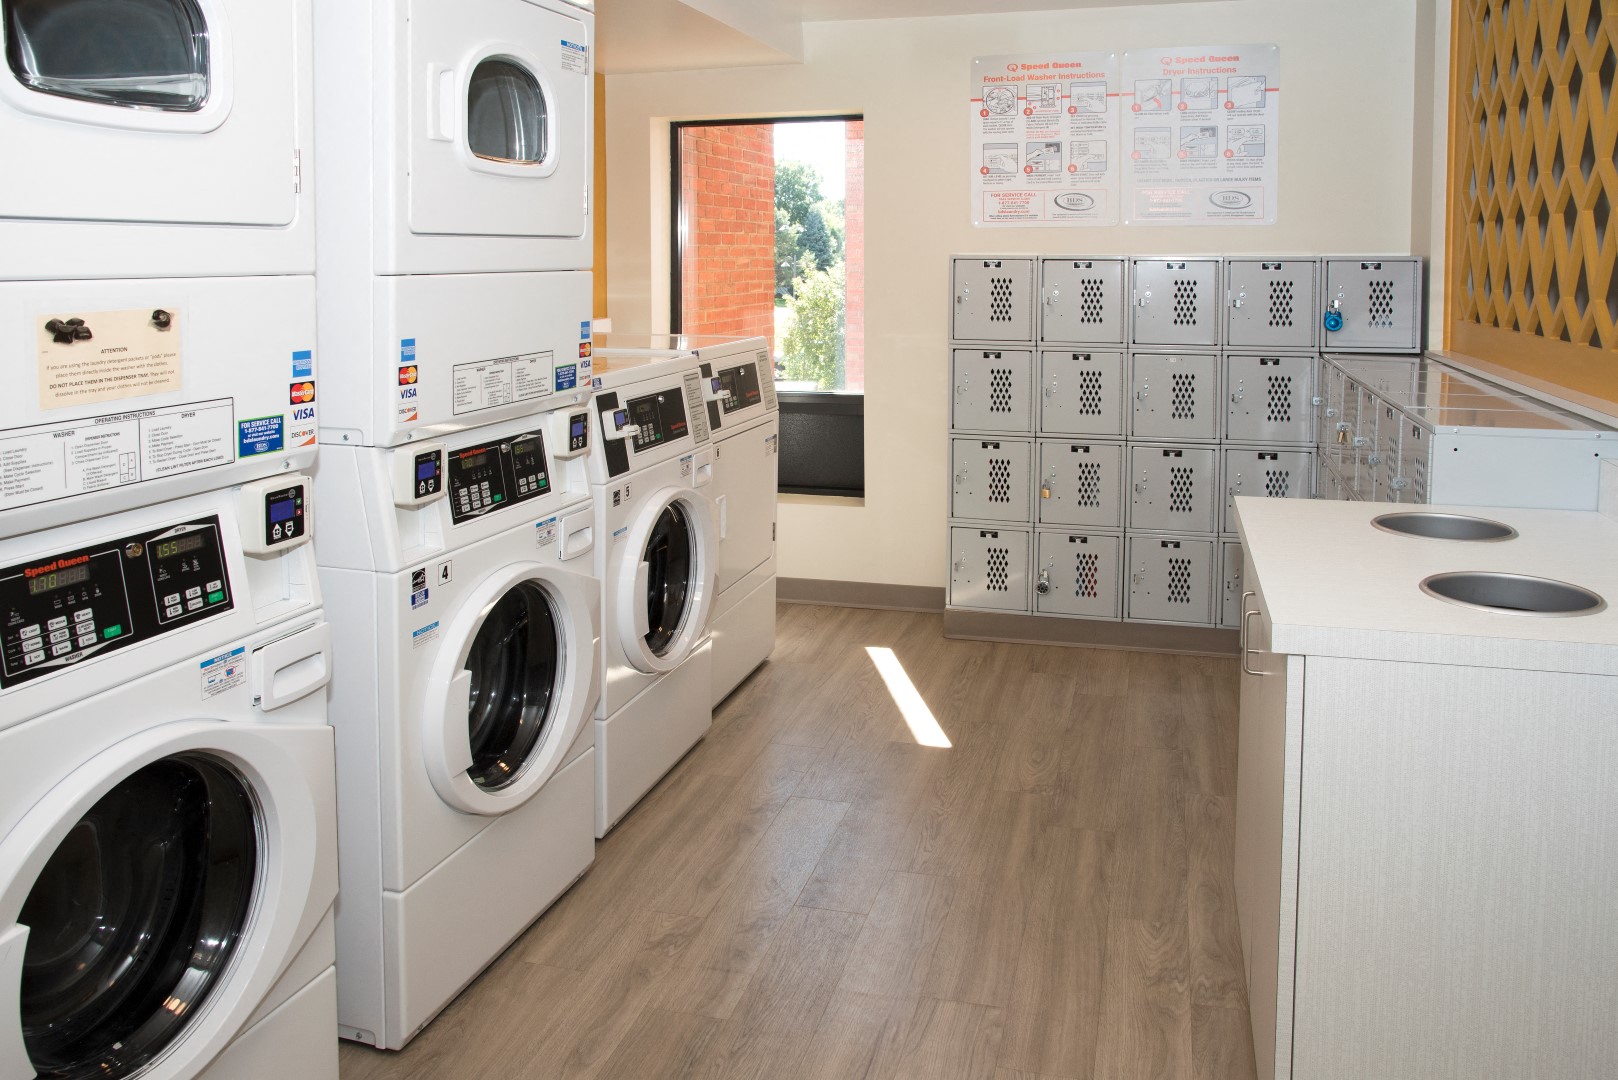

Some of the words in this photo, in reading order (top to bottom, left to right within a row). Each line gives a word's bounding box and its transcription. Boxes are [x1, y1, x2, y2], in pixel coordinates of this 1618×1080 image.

[1175, 56, 1206, 64] Speed
[1020, 62, 1049, 72] Speed
[1052, 61, 1082, 70] Queen
[1188, 66, 1236, 74] Instructions
[984, 74, 1025, 82] Front-Load
[1058, 72, 1105, 80] Instructions
[292, 388, 314, 397] MasterCard
[400, 388, 417, 399] VISA
[94, 414, 122, 425] OPERATING
[123, 410, 156, 422] INSTRUCTIONS
[292, 407, 314, 420] VISA
[251, 419, 269, 427] SERVICE
[53, 430, 75, 439] WASHER
[626, 486, 630, 498] 5
[24, 562, 57, 578] Speed
[58, 555, 89, 568] Queen
[442, 565, 448, 580] 4
[64, 652, 84, 662] WASHER
[214, 652, 232, 663] NOTICE
